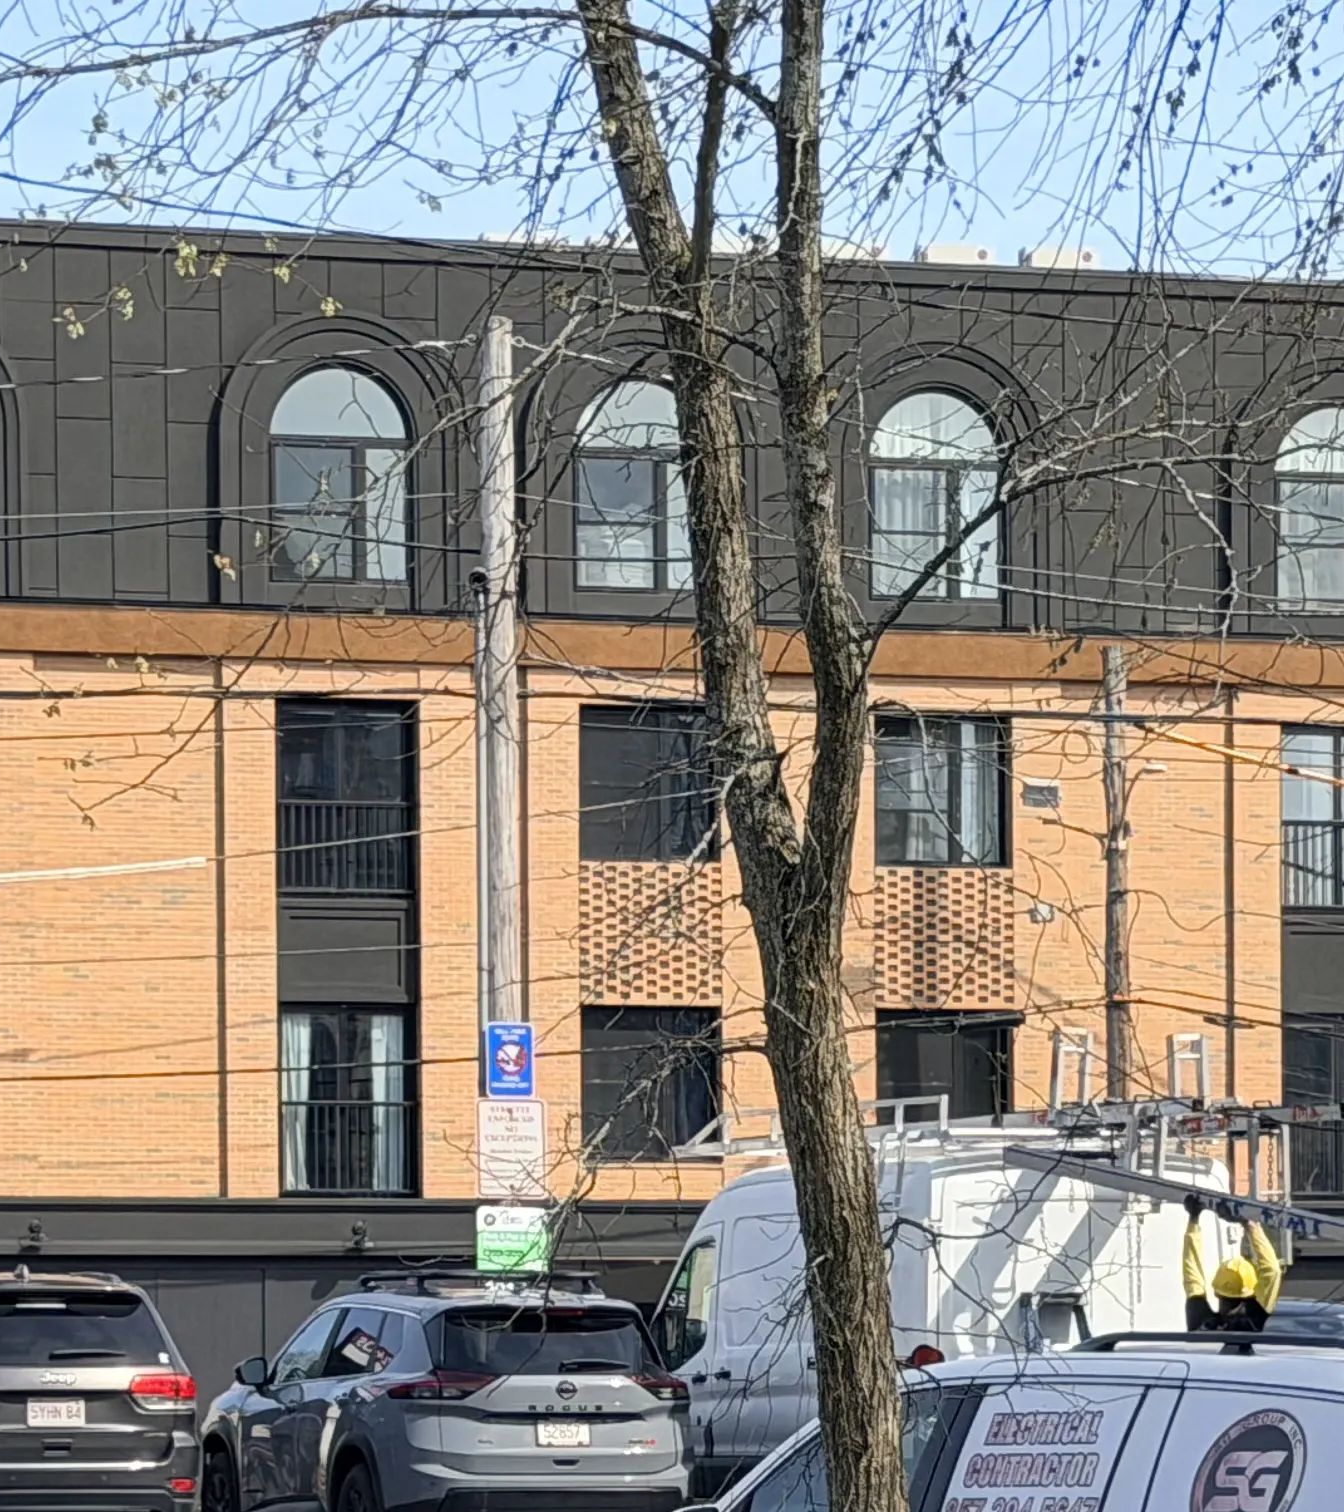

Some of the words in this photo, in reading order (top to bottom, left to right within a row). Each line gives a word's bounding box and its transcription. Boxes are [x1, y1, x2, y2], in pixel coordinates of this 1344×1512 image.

[39, 1369, 77, 1386] Jeep
[983, 1410, 1104, 1446] ELECTRICAL
[963, 1451, 1100, 1488] CONTRACTOR
